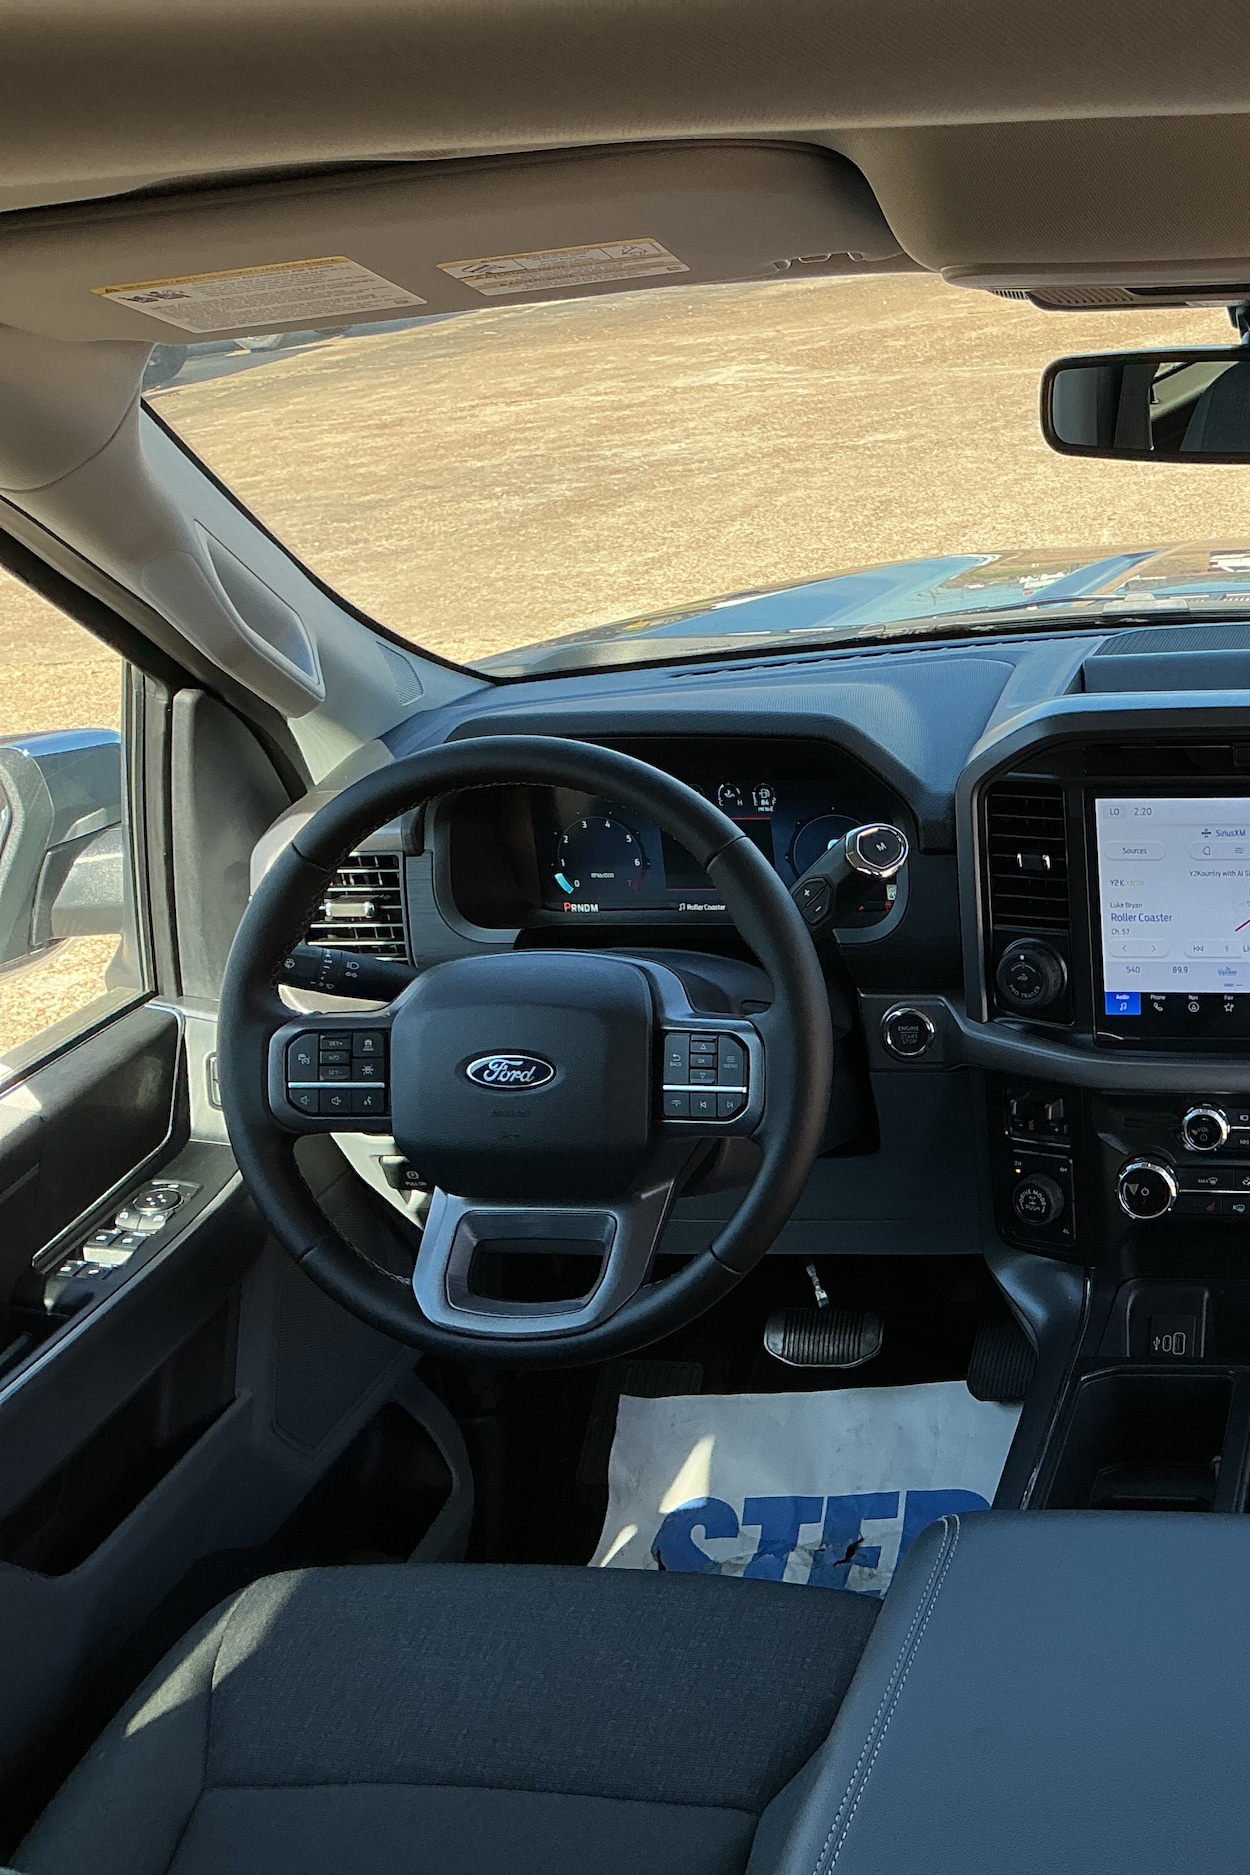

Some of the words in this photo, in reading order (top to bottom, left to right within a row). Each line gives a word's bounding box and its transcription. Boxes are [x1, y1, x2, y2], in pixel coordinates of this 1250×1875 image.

[1110, 808, 1120, 816] LO
[1134, 808, 1153, 816] 2:20
[582, 820, 588, 829] 3
[605, 820, 611, 829] 4
[563, 835, 569, 844] 2
[626, 835, 632, 843] 5
[876, 842, 887, 852] M
[1122, 847, 1147, 855] Sources
[561, 859, 565, 867] 1
[634, 858, 641, 867] 6
[1189, 870, 1221, 878] Y2Kountry
[574, 880, 580, 888] 0
[1125, 902, 1143, 910] Bryan
[1110, 913, 1137, 922] Roller
[1138, 913, 1173, 923] Coaster
[1126, 966, 1141, 974] 540
[484, 1059, 537, 1082] Ford
